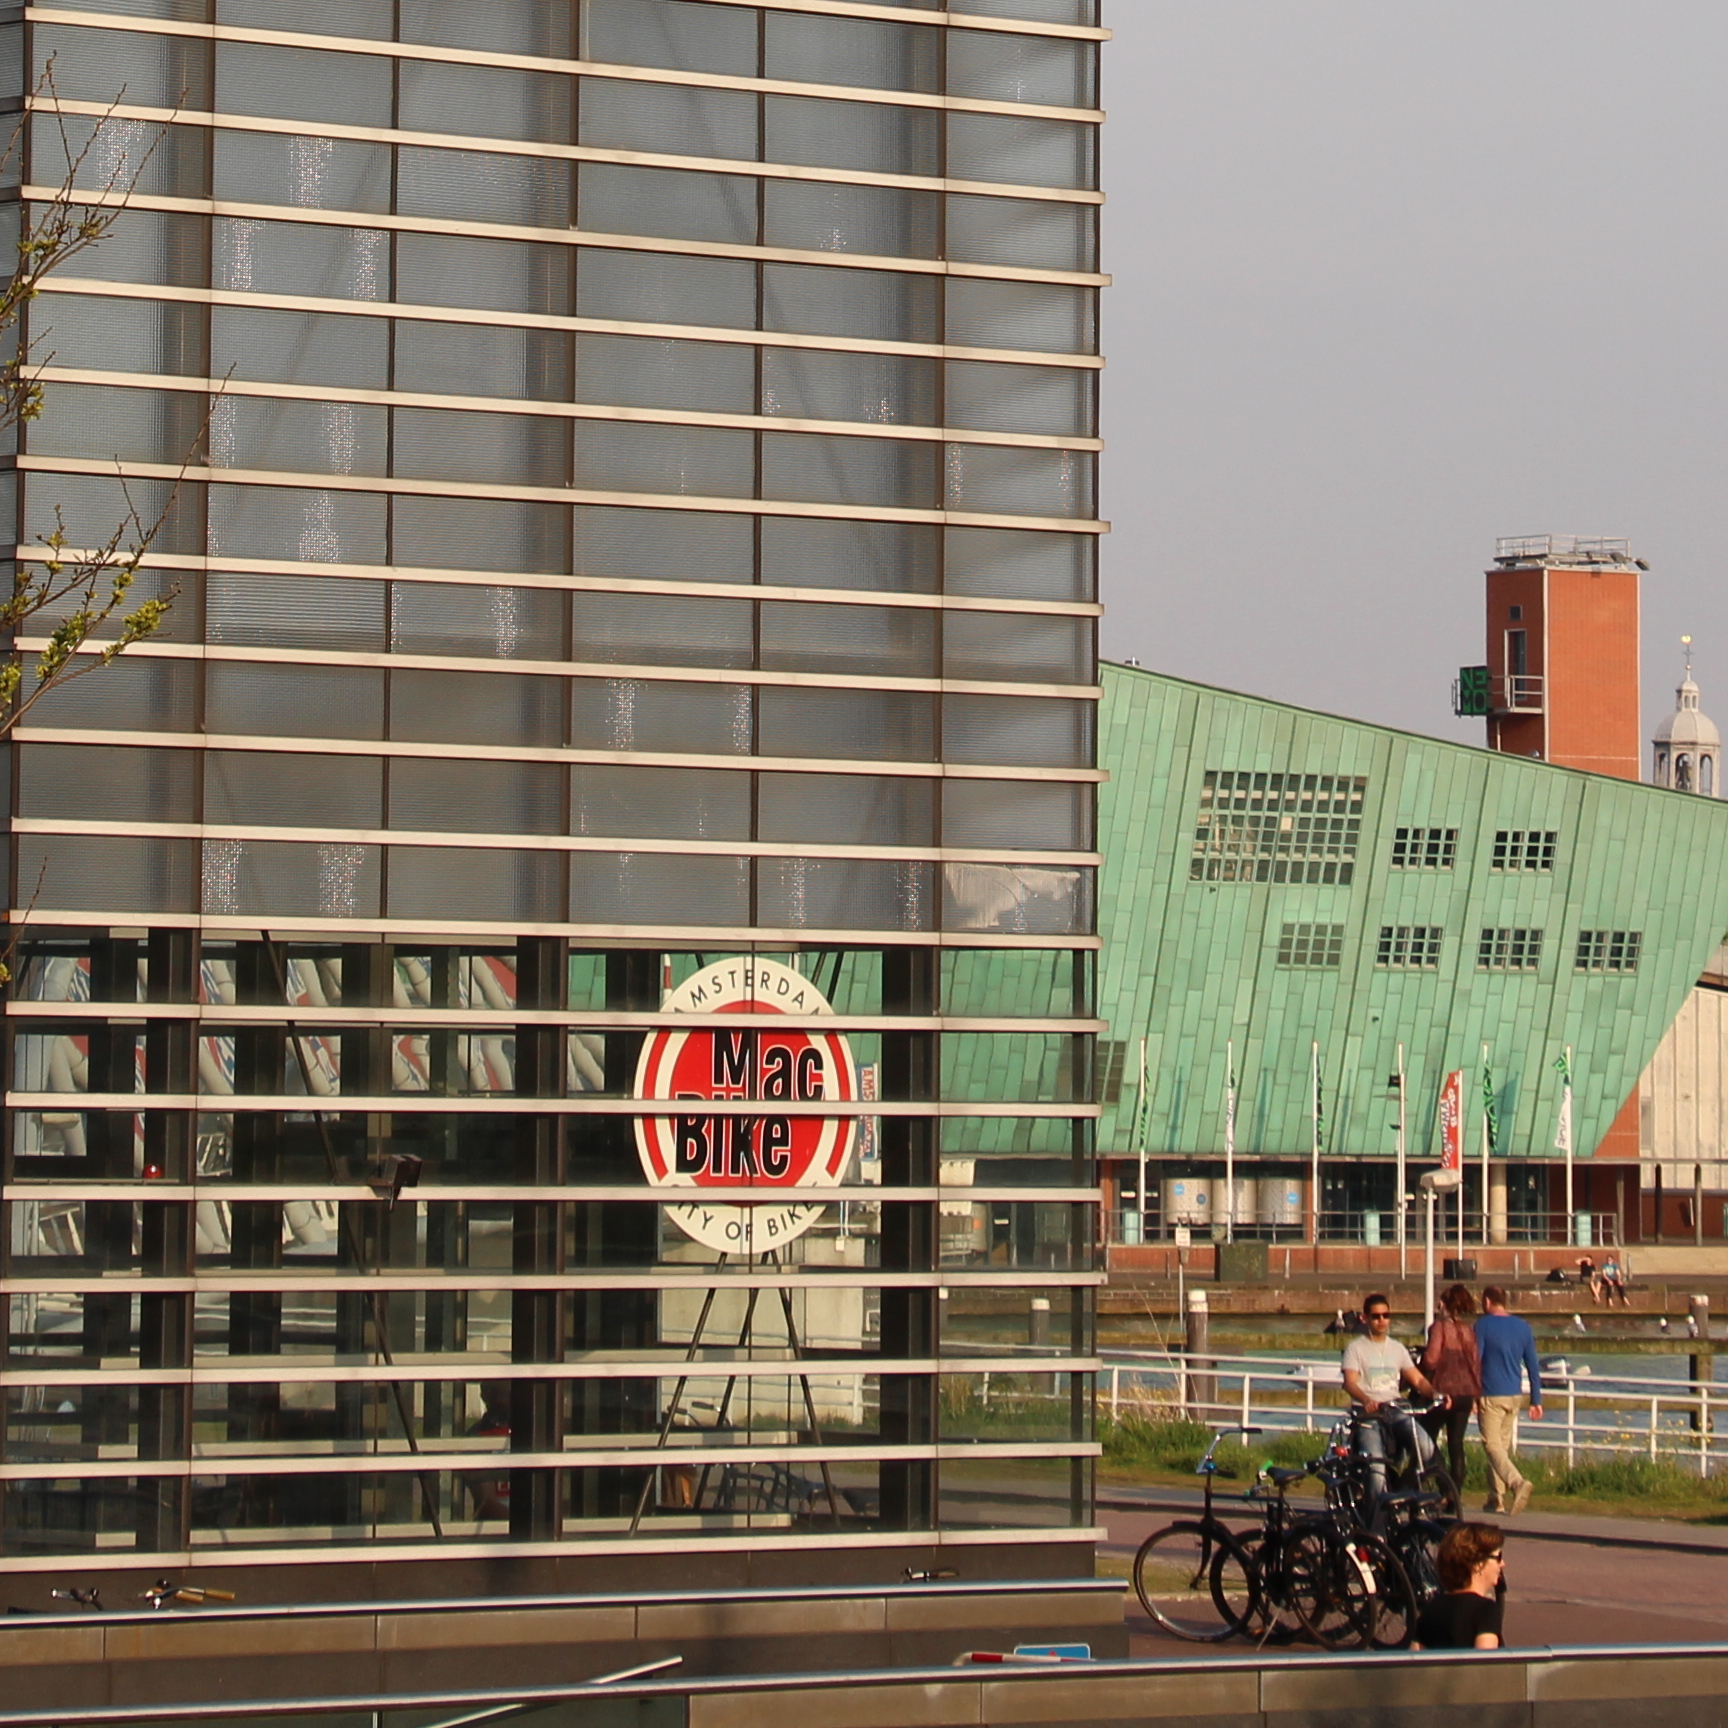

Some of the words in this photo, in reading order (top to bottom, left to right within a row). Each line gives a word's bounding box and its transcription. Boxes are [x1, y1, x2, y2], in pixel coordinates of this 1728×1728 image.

[673, 968, 822, 1015] MSTERDA
[711, 1026, 825, 1102] Mac
[674, 1091, 792, 1179] Bike
[670, 1183, 715, 1231] ITY
[725, 1221, 754, 1242] OF
